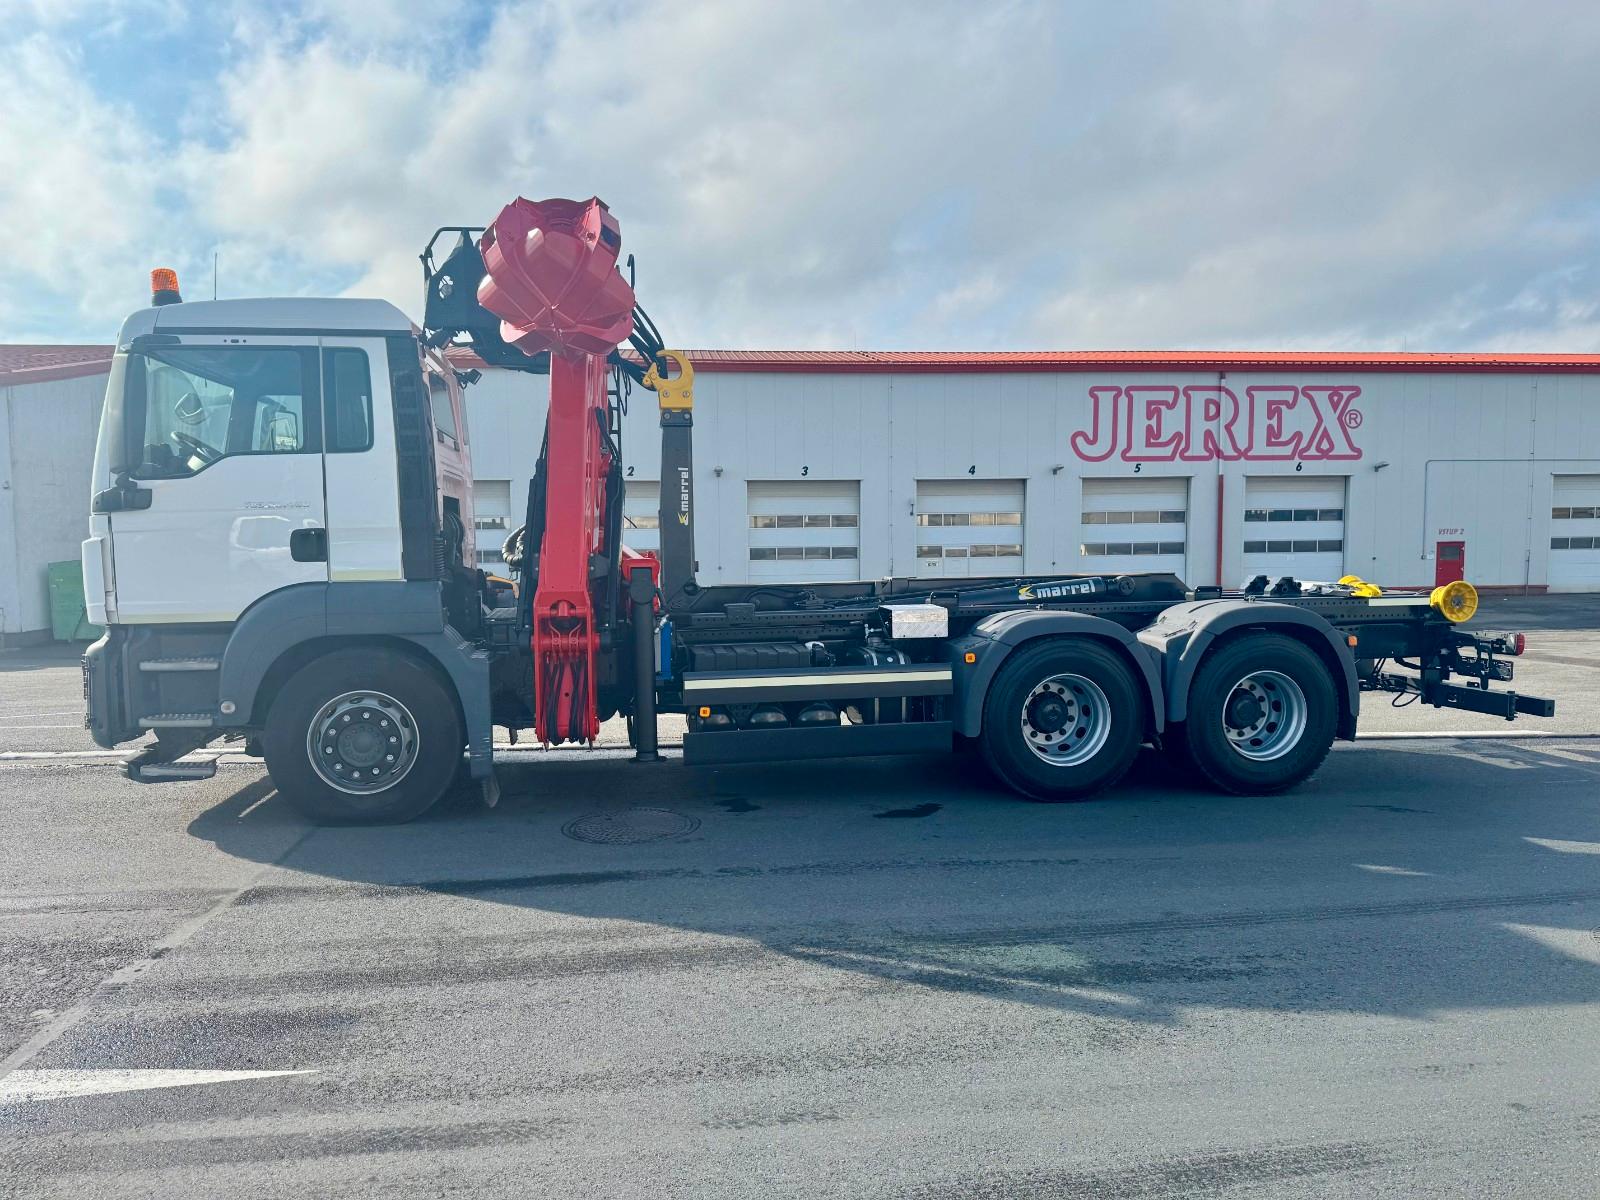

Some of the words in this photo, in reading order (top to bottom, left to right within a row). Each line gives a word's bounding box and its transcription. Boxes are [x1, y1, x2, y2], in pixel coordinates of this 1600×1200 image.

[627, 465, 635, 476] 2
[801, 465, 809, 476] 3
[968, 464, 976, 476] 4
[1133, 463, 1142, 473] 5
[1295, 461, 1303, 472] 6
[677, 467, 688, 511] marrel
[1036, 579, 1095, 598] marrel
